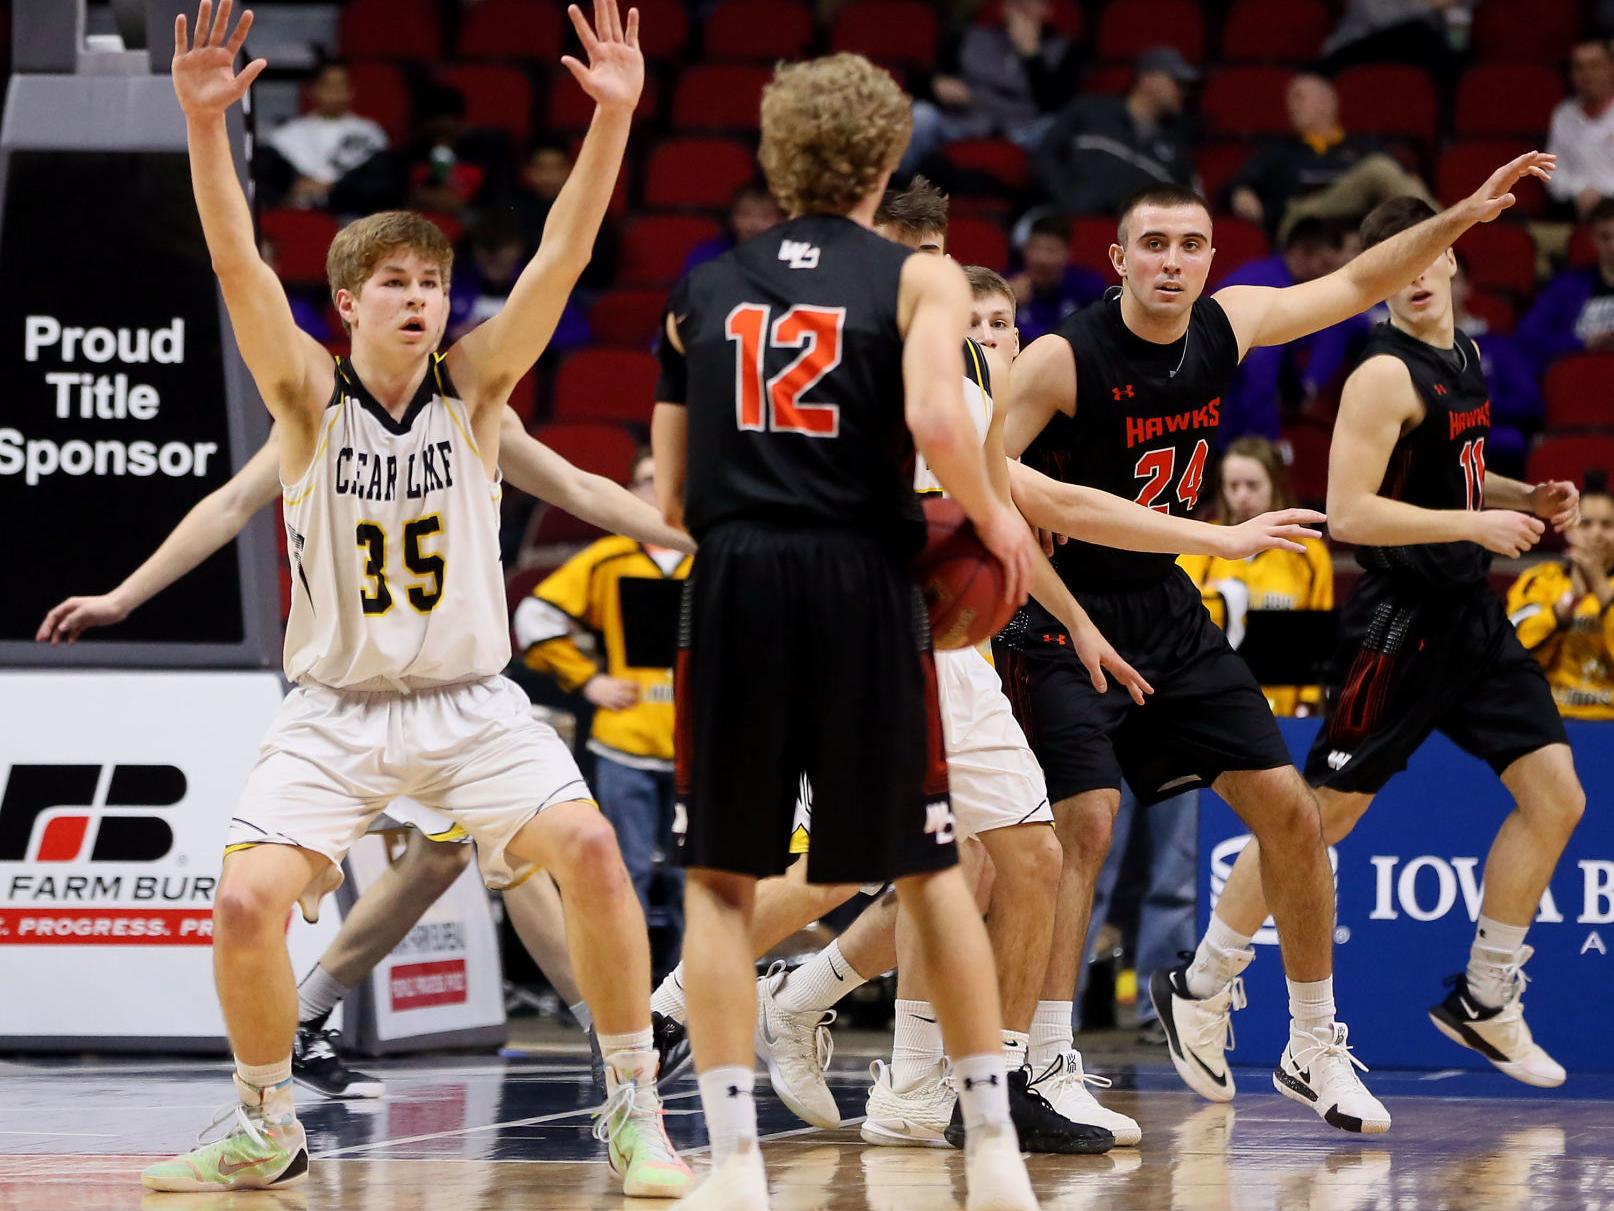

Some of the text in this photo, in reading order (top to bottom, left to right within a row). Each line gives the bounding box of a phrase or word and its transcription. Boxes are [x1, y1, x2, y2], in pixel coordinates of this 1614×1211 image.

[24, 314, 185, 364] Proud
[45, 371, 161, 420] Title
[725, 302, 847, 438] 12
[1126, 396, 1221, 448] HAWKS
[1449, 399, 1492, 441] HAWKS
[0, 427, 218, 486] Sponsor
[336, 447, 397, 501] CEAR
[1134, 438, 1209, 515] 24
[1459, 437, 1486, 512] 11
[354, 511, 446, 617] 35
[8, 876, 216, 901] FARM BUR
[18, 917, 171, 936] PROGRESS.
